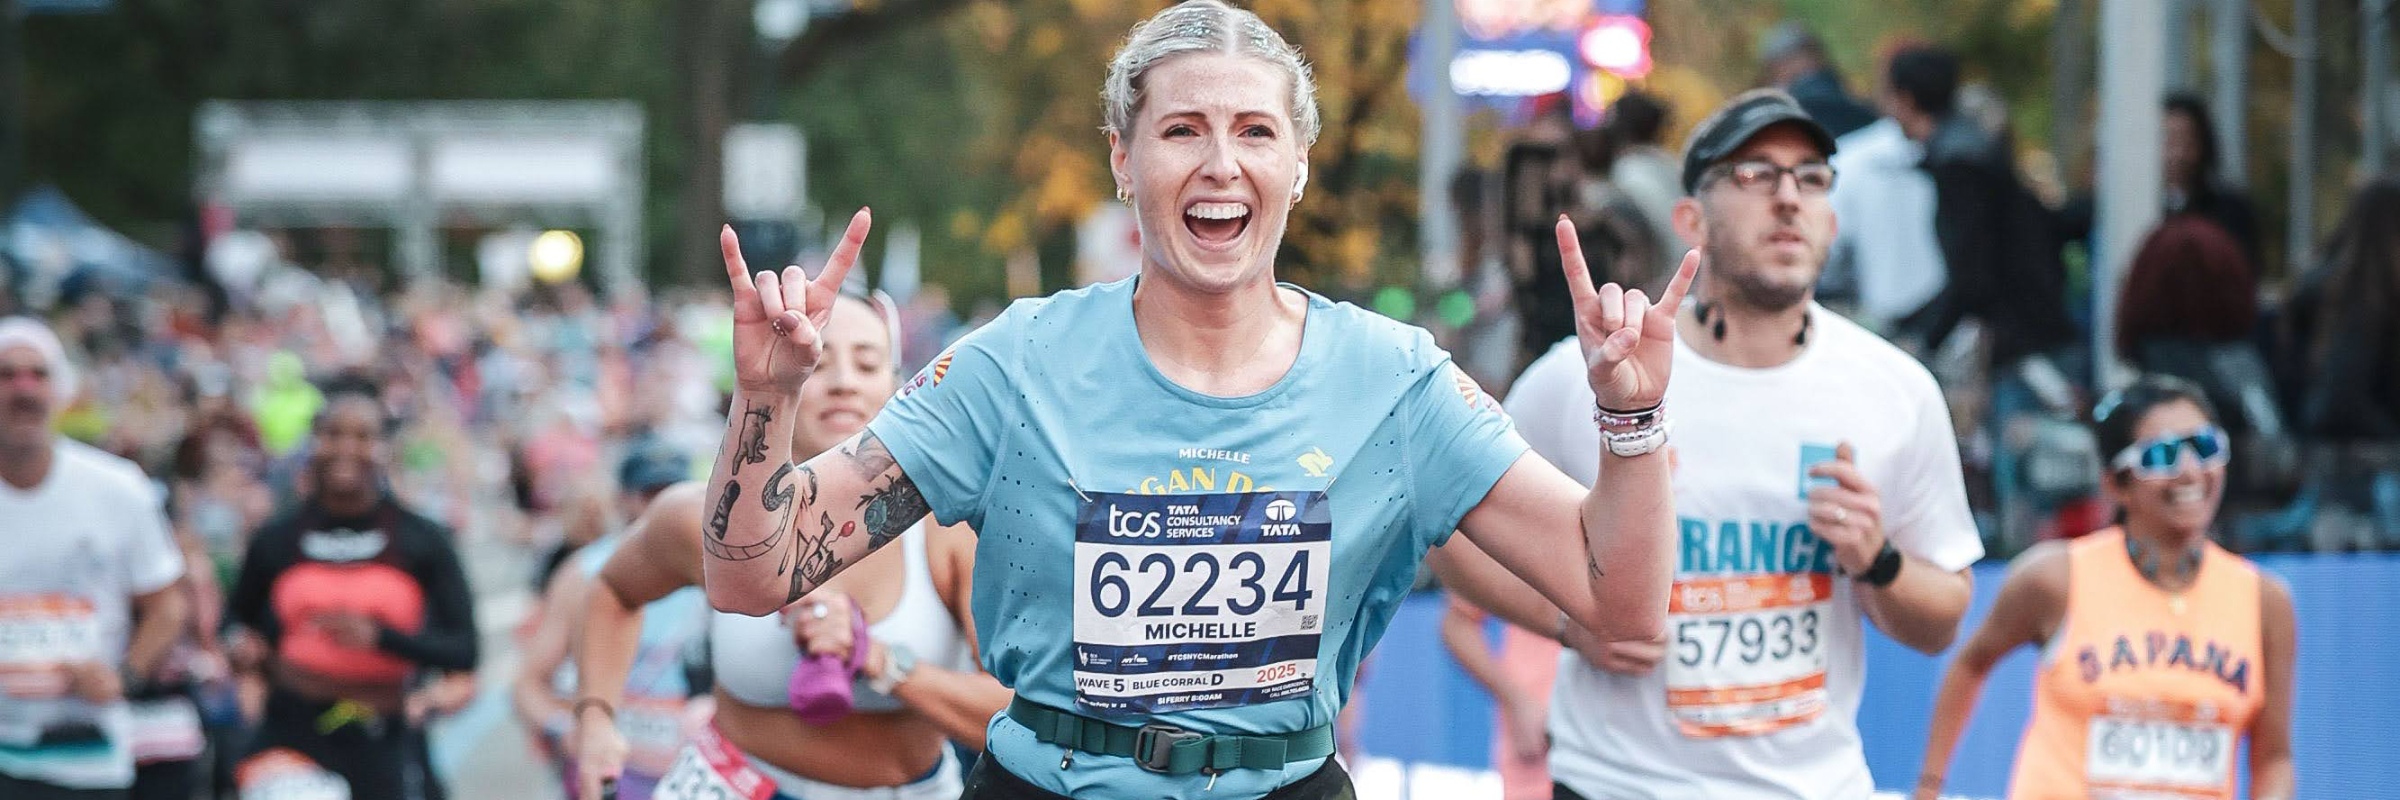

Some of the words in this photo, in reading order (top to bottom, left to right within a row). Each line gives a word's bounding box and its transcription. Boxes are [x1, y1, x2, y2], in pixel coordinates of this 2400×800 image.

[1179, 448, 1251, 465] MICHELLE
[1124, 466, 1215, 495] GAN
[1226, 471, 1275, 494] D
[1167, 505, 1199, 515] TATA
[1109, 504, 1161, 538] tcs
[1166, 514, 1241, 527] CONSULTANCY
[1166, 527, 1215, 538] SERVICES
[1260, 524, 1302, 537] TATA
[1089, 549, 1313, 618] 62234
[1145, 621, 1257, 640] MICHELLE
[1677, 609, 1819, 667] 57933
[1168, 653, 1239, 661] #TCSNYCMarathon
[2078, 630, 2249, 693] SAPANA
[1132, 679, 1160, 690] BLUE
[1161, 677, 1208, 687] CORRAL
[1211, 673, 1224, 686] D
[1257, 664, 1296, 683] 2025
[1077, 677, 1110, 689] WAVE
[1113, 678, 1125, 693] 5
[1165, 696, 1190, 704] FERRY
